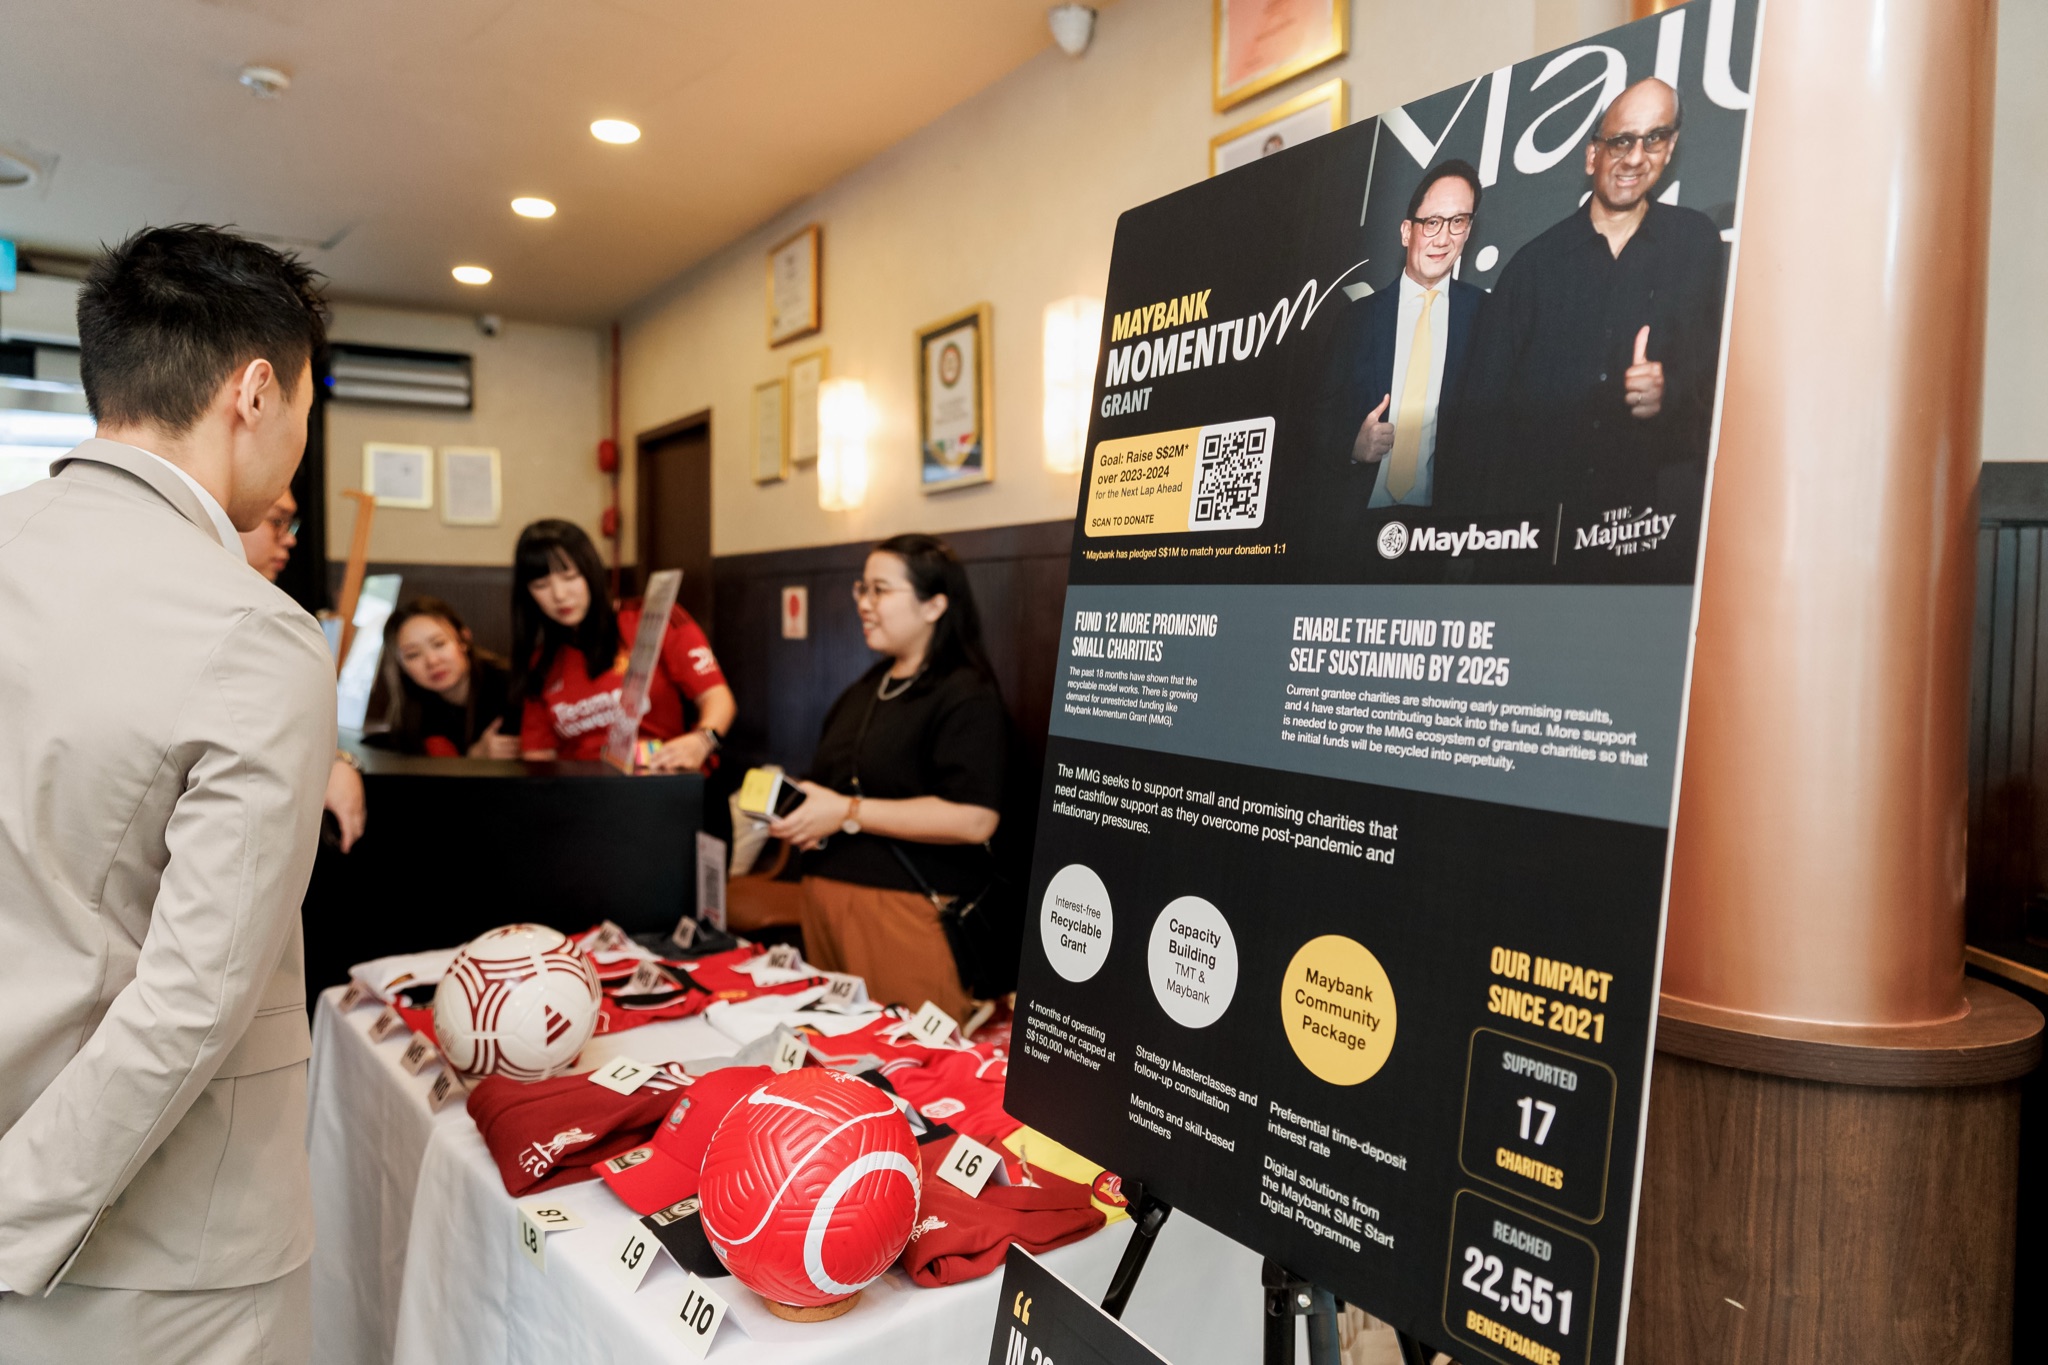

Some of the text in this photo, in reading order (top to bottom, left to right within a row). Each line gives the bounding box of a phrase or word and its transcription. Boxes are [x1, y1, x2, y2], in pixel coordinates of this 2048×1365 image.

[1105, 259, 1369, 387] MOMENTUM
[1111, 289, 1211, 342] MAYBANK
[1101, 387, 1152, 418] GRANT
[1098, 466, 1169, 484] over 2023-2024
[1100, 452, 1124, 467] Goal:
[1126, 449, 1153, 463] Raise
[1096, 483, 1182, 499] for the Next Lap Ahead
[1092, 514, 1154, 528] SCAN TO DONATE
[1601, 506, 1632, 522] THE
[1116, 550, 1127, 558] has
[1129, 548, 1156, 560] pledged
[1158, 547, 1179, 558] S$1M
[1181, 548, 1187, 556] to
[1190, 547, 1213, 556] match
[1216, 547, 1232, 557] your
[1234, 544, 1271, 555] donation
[1273, 544, 1286, 553] 1:1
[1410, 521, 1540, 556] Maybank
[1075, 611, 1218, 637] FUND 12 MORE PROMISING
[1293, 617, 1495, 650] ENABLE THE FUND TO BE
[1072, 636, 1163, 662] SMALL CHARITIES
[1289, 647, 1510, 686] SELF SUSTAINING BY 2025
[1065, 704, 1173, 727] Maybank Momentum Grant (MMG).
[1286, 684, 1613, 725] Current grantee charities are showing early promising results,
[1282, 730, 1515, 772] the initial funds will be recycled into perpetuity.
[1052, 800, 1151, 834] inflationary pressures.
[1058, 763, 1398, 840] The MMG seeks to support small and promising charities that
[1055, 784, 1395, 864] need cashflow support as they overcome post-pandemic and
[1056, 895, 1101, 919] Interest-free
[1050, 911, 1102, 939] Recyclable
[1169, 918, 1221, 948] Capacity
[1060, 934, 1087, 954] Grant
[1169, 939, 1216, 969] Building
[1175, 962, 1205, 984] TMT &
[1306, 968, 1373, 1002] Maybank
[1490, 946, 1613, 1003] OUR IMPACT
[1166, 978, 1210, 1004] Maybank
[923, 1015, 942, 1036] L1
[1030, 1000, 1106, 1043] 4 months of operating
[1295, 989, 1381, 1032] Community
[1487, 984, 1605, 1043] SINCE 2021
[1026, 1028, 1101, 1071] S$150,000 whichever
[1027, 1015, 1115, 1062] expenditure or capped at
[1302, 1015, 1366, 1050] Package
[1024, 1044, 1050, 1064] is lower
[1502, 1051, 1578, 1092] SUPPORTED
[610, 1064, 640, 1081] L7
[1134, 1061, 1230, 1113] follow-up consultation
[1136, 1045, 1258, 1106] Strategy Masterclasses and
[1128, 1111, 1172, 1140] volunteers
[1130, 1092, 1235, 1152] Mentors and skill-based
[1268, 1119, 1330, 1158] interest rate
[1270, 1101, 1407, 1171] Preferential time-deposit
[1516, 1096, 1557, 1146] 17
[955, 1149, 982, 1178] L6
[1495, 1147, 1564, 1190] CHARITIES
[1264, 1155, 1380, 1221] Digital solutions from
[537, 1209, 568, 1223] L8
[1260, 1192, 1361, 1252] Digital Programme
[1262, 1174, 1395, 1249] the Maybank SME Start
[524, 1222, 537, 1254] L8
[621, 1235, 645, 1270] L9
[1493, 1220, 1552, 1262] REACHED
[1462, 1246, 1573, 1336] 22,551
[680, 1290, 714, 1335] L10
[1005, 1326, 1027, 1365] IN
[1466, 1310, 1561, 1365] BENEFICIARIES
